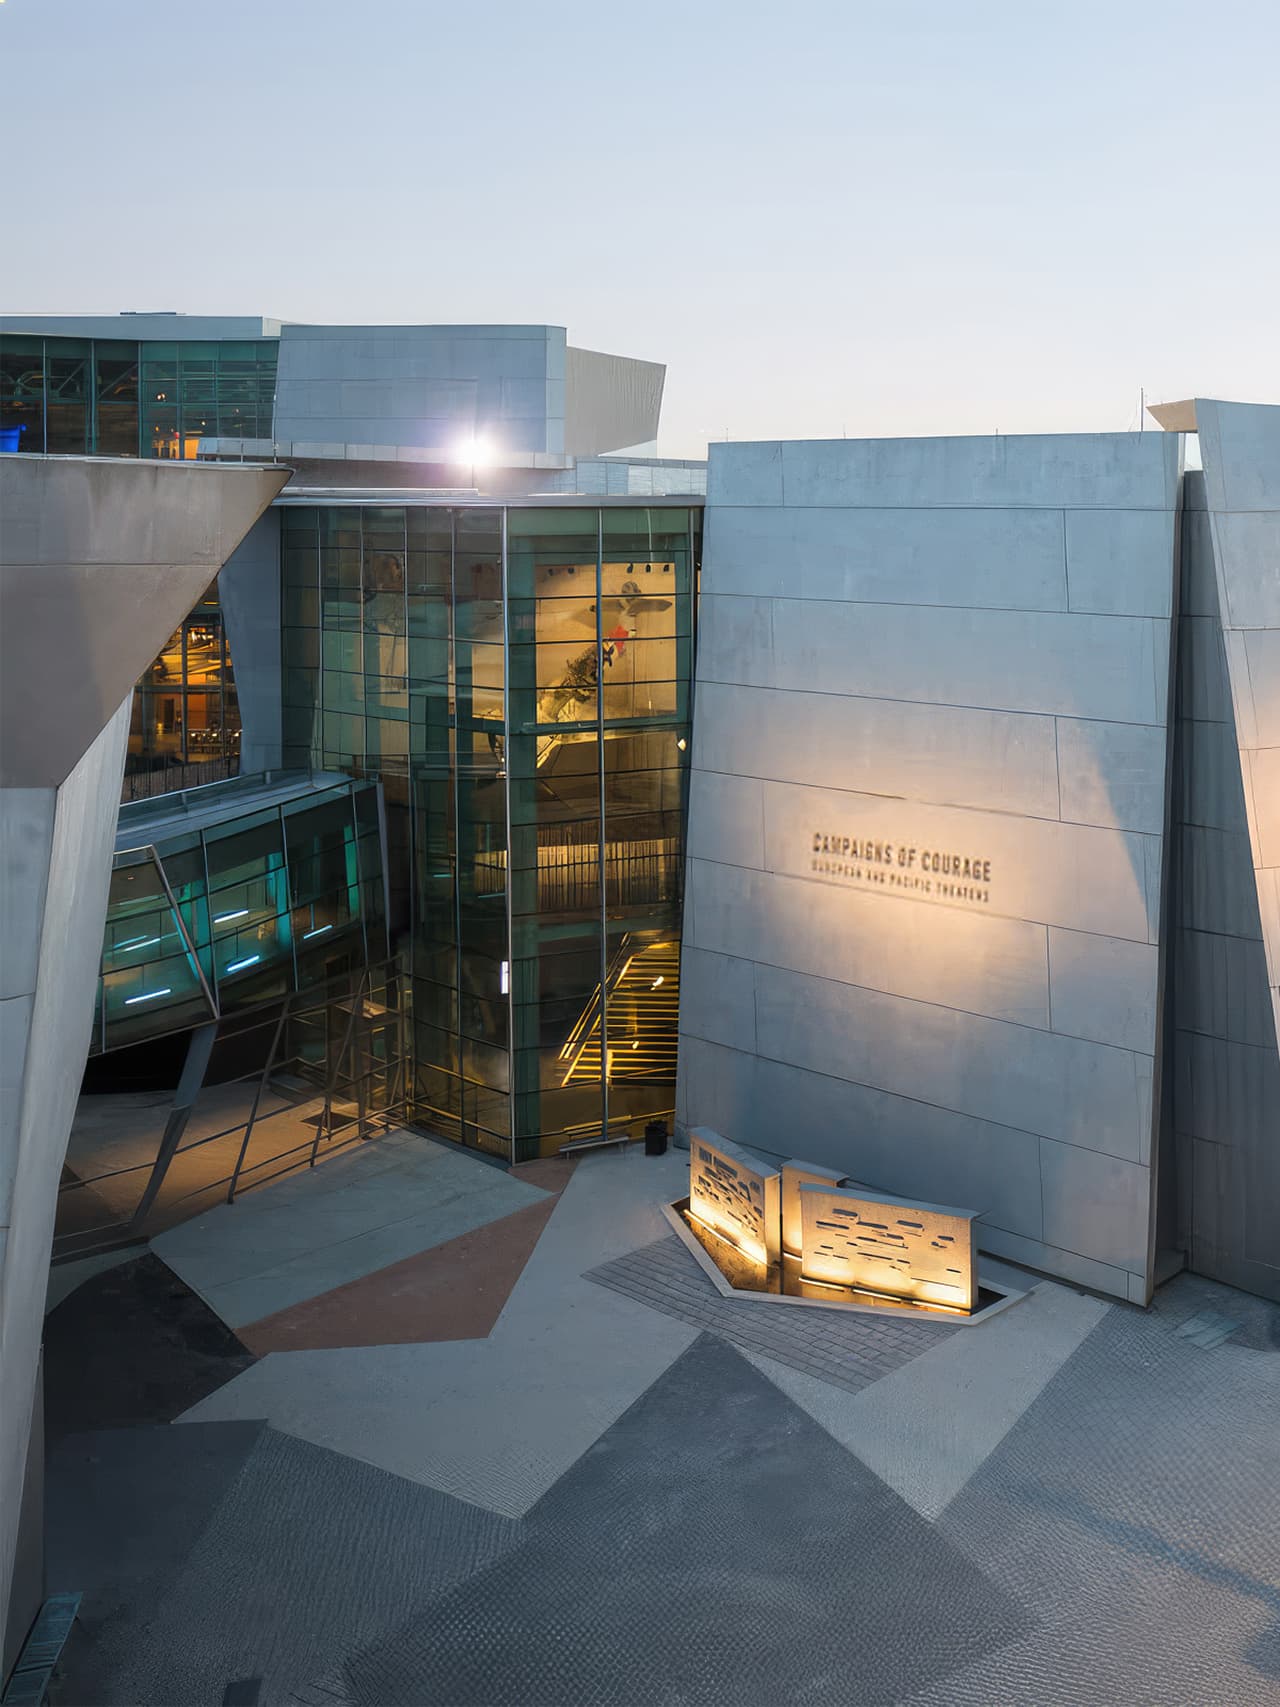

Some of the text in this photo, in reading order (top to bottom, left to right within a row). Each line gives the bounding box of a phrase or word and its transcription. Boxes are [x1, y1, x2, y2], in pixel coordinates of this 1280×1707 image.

[812, 832, 991, 882] CAMPAIGNS OF COURAGE
